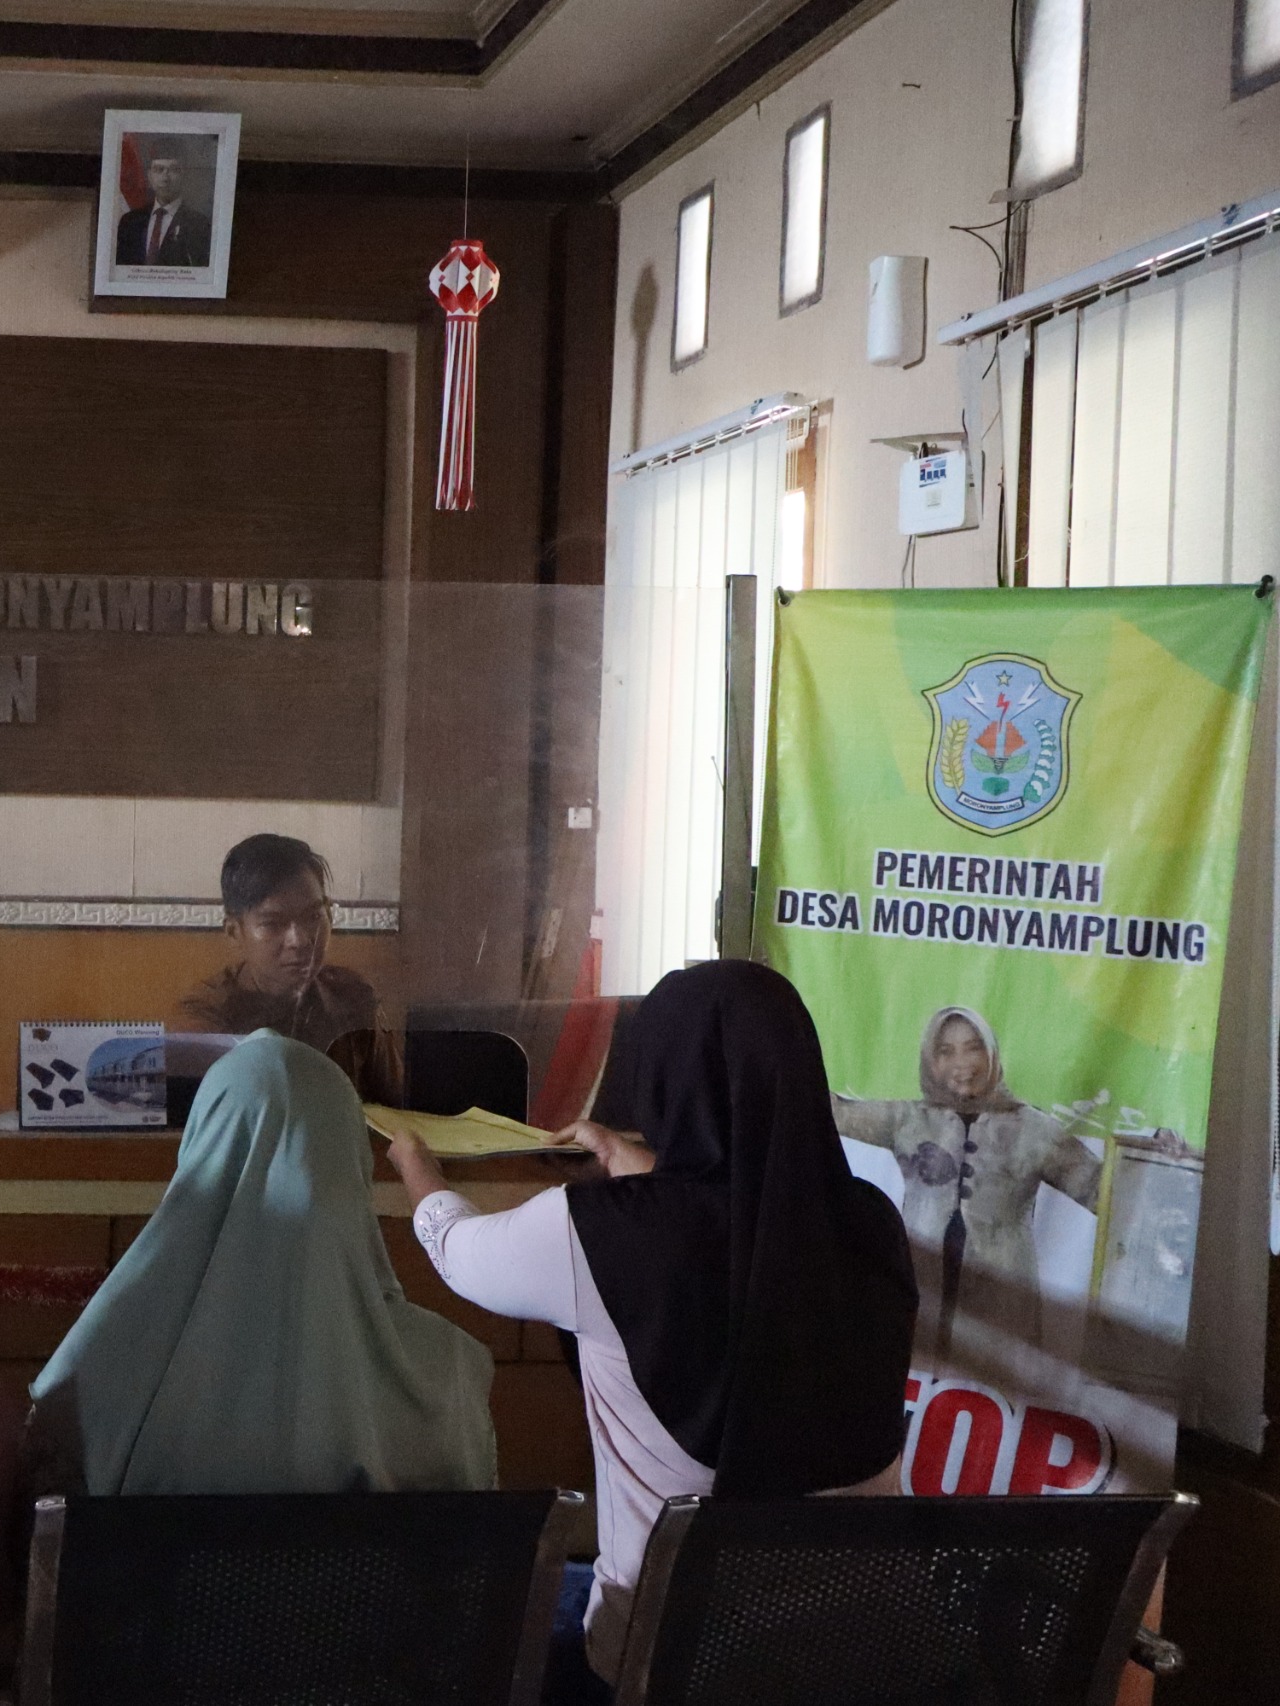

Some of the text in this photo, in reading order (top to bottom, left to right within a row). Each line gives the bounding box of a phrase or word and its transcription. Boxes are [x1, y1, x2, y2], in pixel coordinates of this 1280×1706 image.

[875, 851, 1102, 902] PEMERINTAH
[776, 890, 1206, 962] DESA MORONYAMPLUNG
